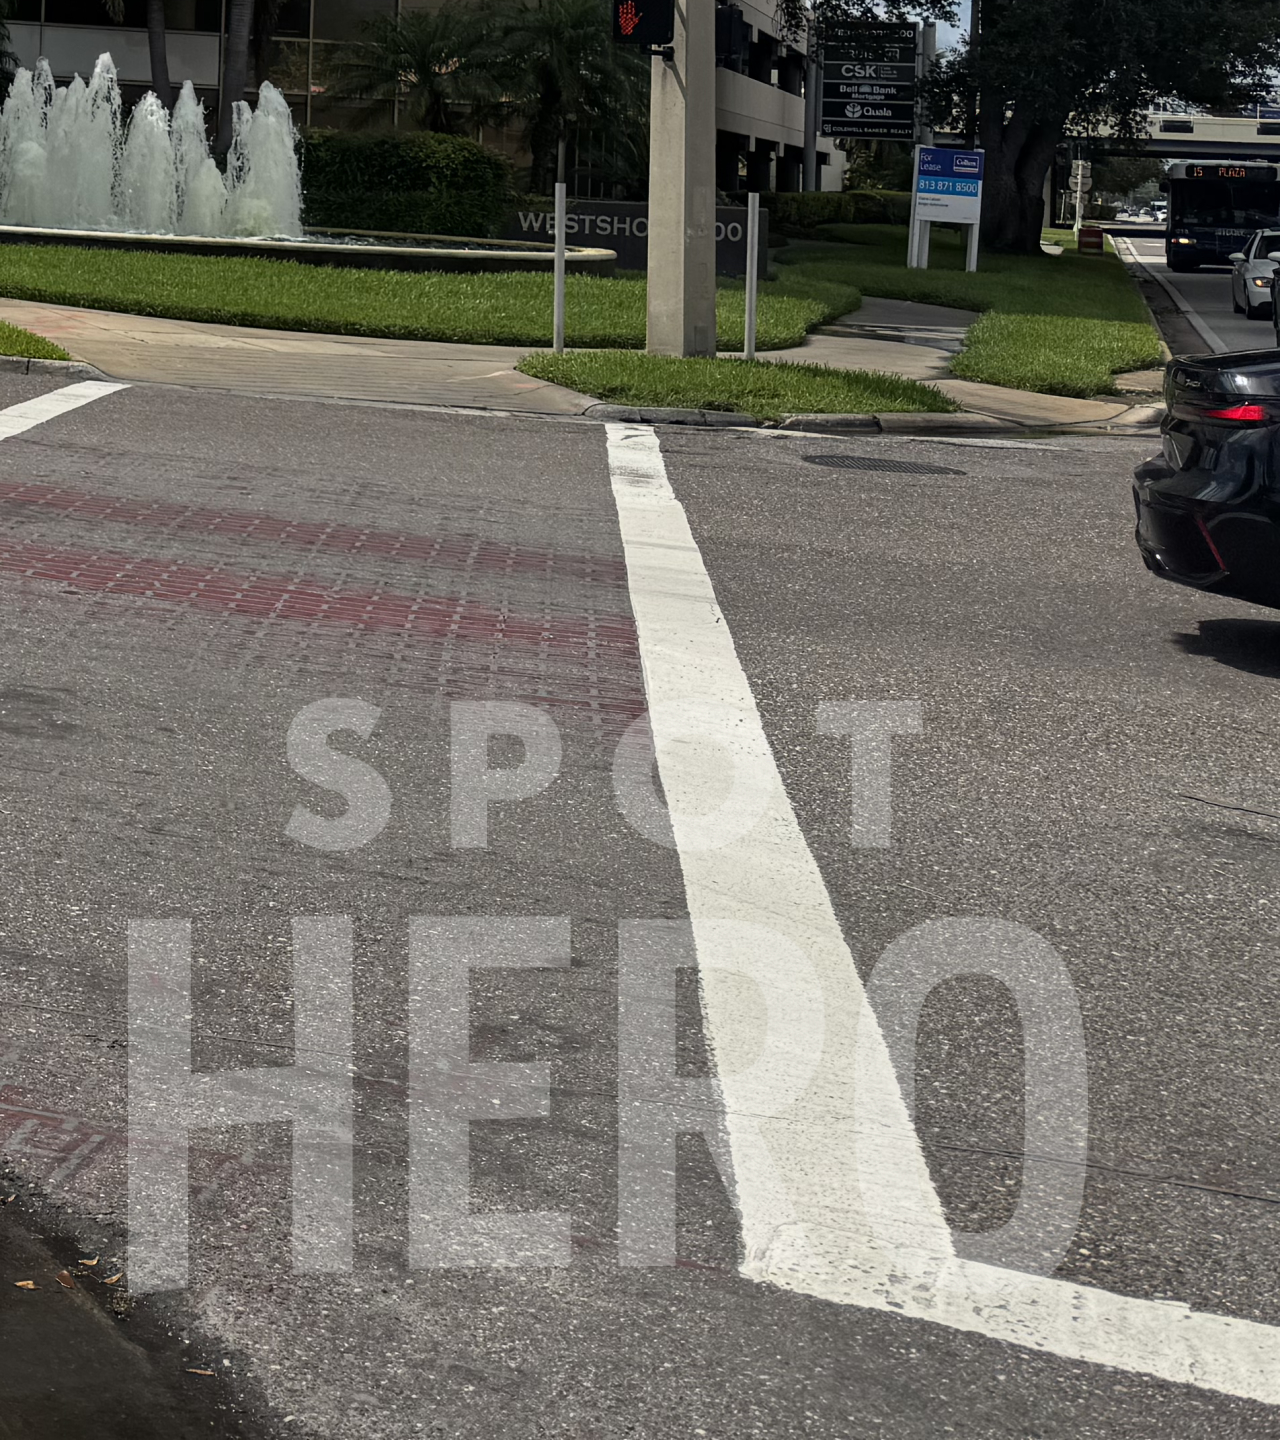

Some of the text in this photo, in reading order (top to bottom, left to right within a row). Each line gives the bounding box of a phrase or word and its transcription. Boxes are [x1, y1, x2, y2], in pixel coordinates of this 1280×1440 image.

[841, 64, 877, 77] CSK
[873, 86, 897, 94] Bank
[863, 107, 892, 116] Quala
[921, 153, 933, 162] For
[920, 162, 942, 171] Lease
[1193, 167, 1246, 177] 15 PLAZA
[919, 180, 978, 193] 813 871 8500
[518, 211, 742, 241] WESTSHO 00
